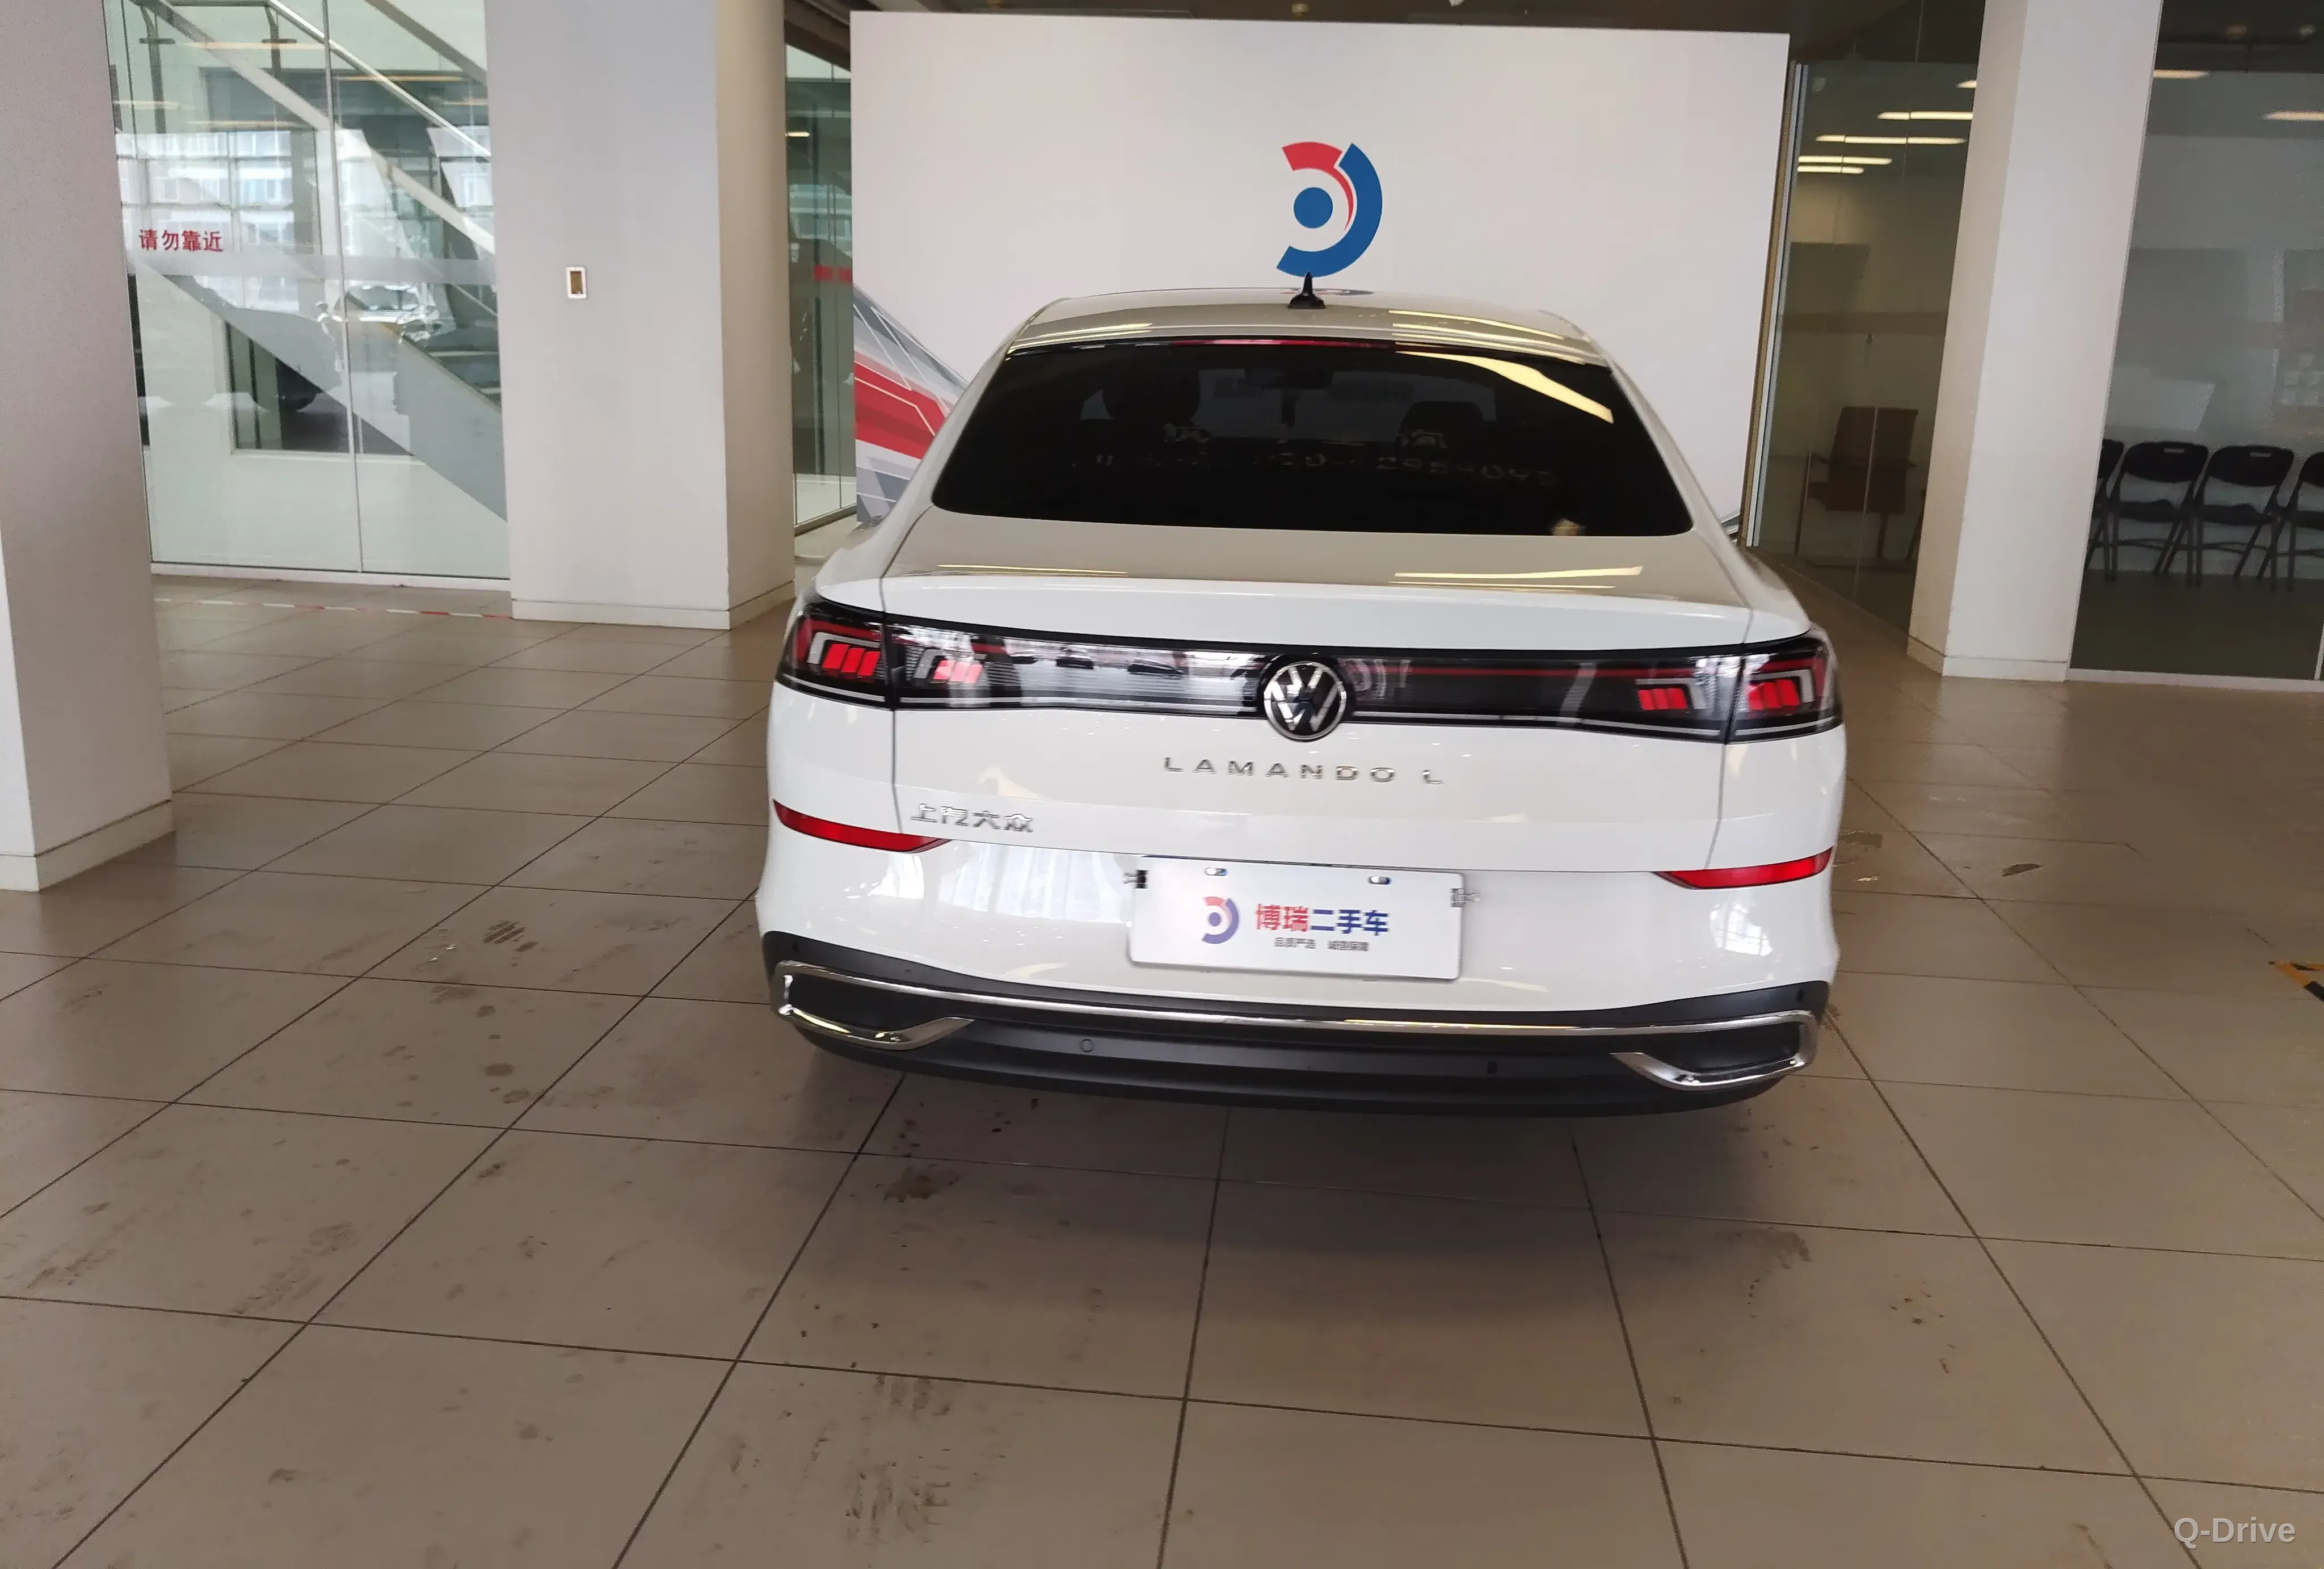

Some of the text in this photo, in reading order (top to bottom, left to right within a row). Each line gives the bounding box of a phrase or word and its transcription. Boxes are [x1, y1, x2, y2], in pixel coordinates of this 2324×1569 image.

[139, 228, 223, 251] 请勿靠近
[1164, 756, 1443, 784] LAMANDO L
[1255, 903, 1390, 935] 博瑞二手车
